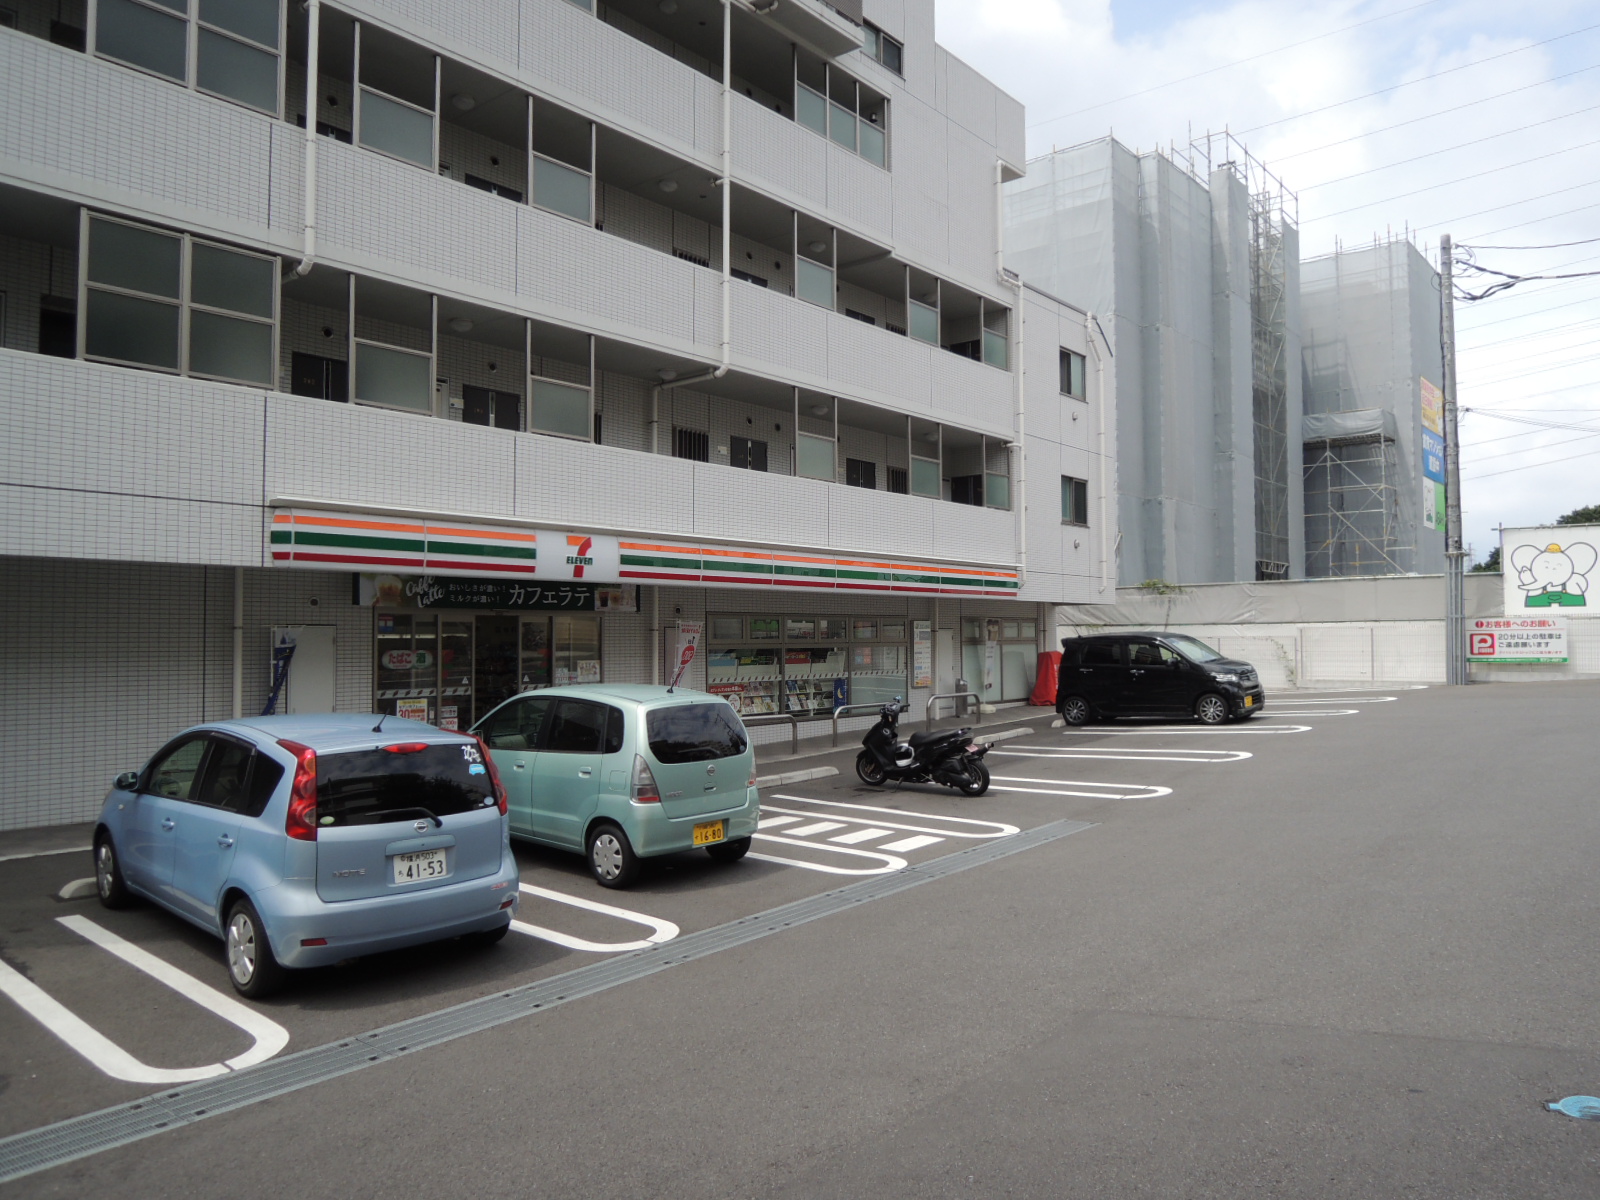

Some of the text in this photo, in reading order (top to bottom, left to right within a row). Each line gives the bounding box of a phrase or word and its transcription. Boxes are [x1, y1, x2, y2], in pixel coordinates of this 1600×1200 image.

[508, 584, 591, 607] カフェラテ
[1498, 633, 1563, 642] 20分以上の駐車は
[388, 652, 412, 664] たばこ
[406, 860, 444, 880] 41-53
